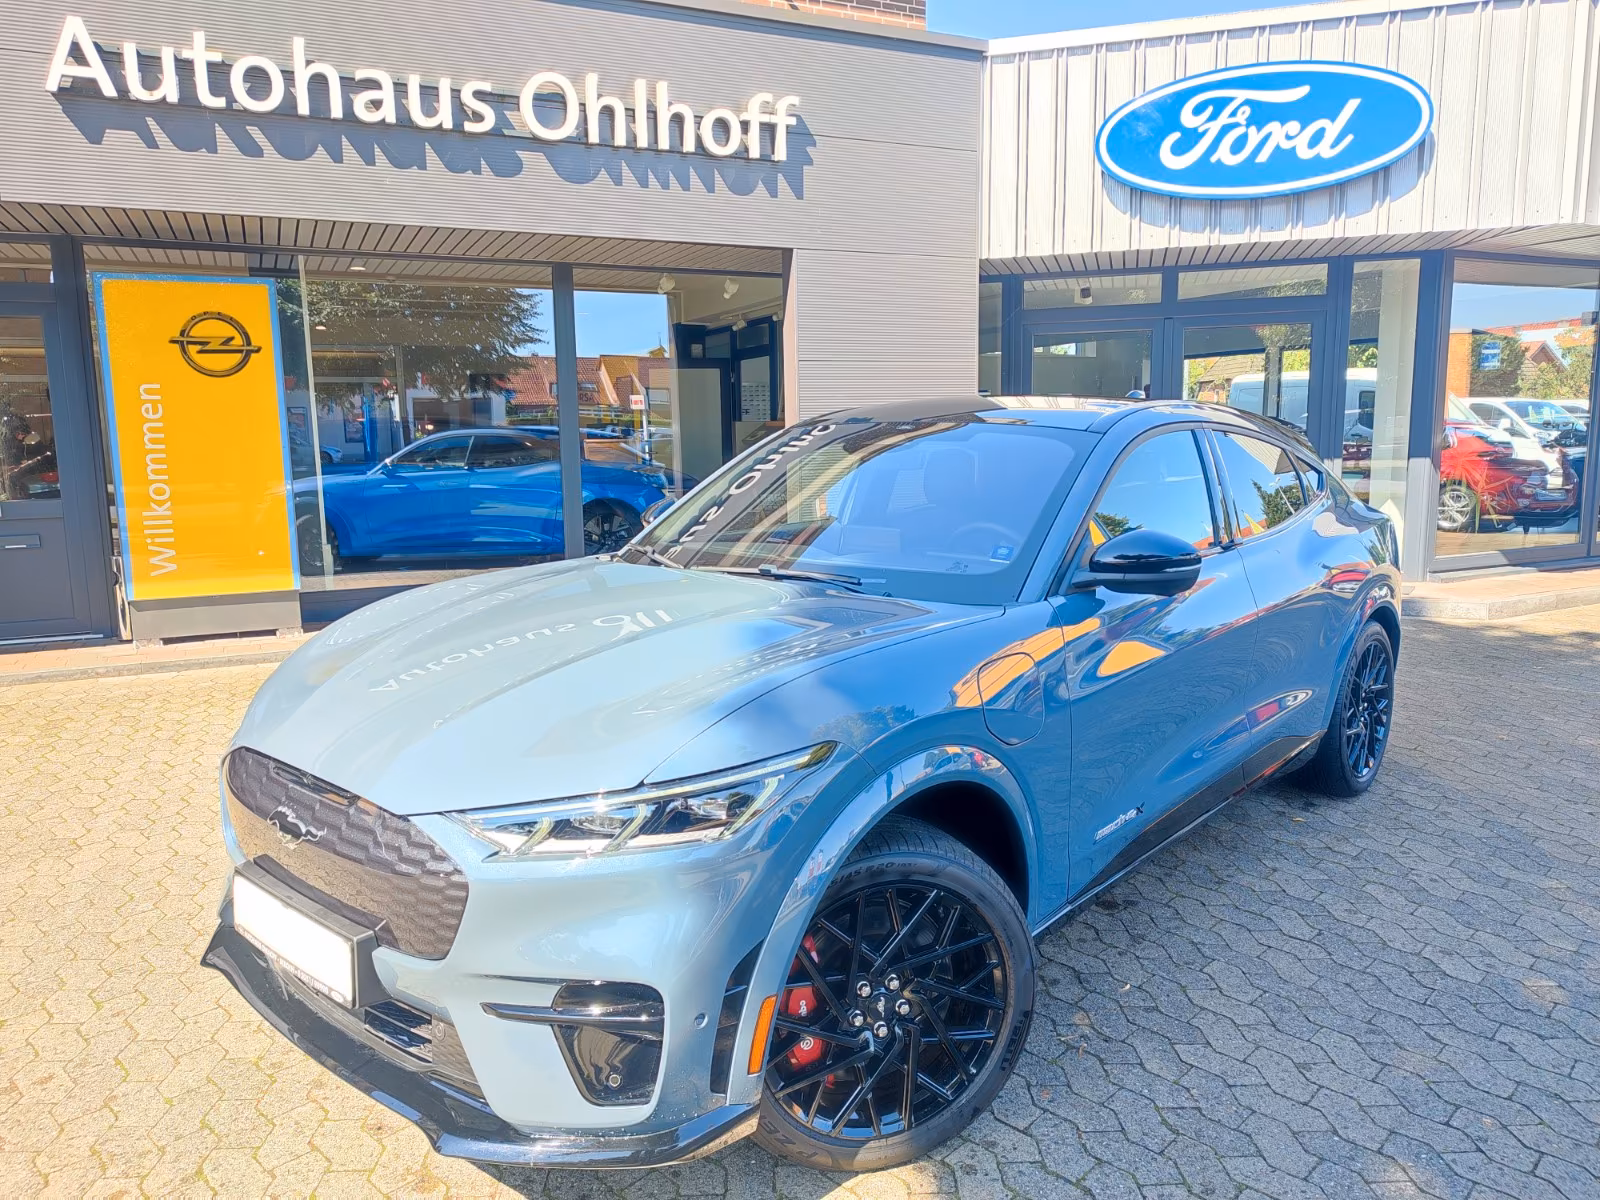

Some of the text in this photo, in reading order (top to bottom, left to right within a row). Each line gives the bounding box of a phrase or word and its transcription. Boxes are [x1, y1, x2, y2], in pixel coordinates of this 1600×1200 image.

[45, 15, 800, 161] Autohaus Ohlhoff
[1159, 84, 1362, 170] Ford
[191, 311, 234, 321] OPEL
[139, 382, 177, 577] Willkommen
